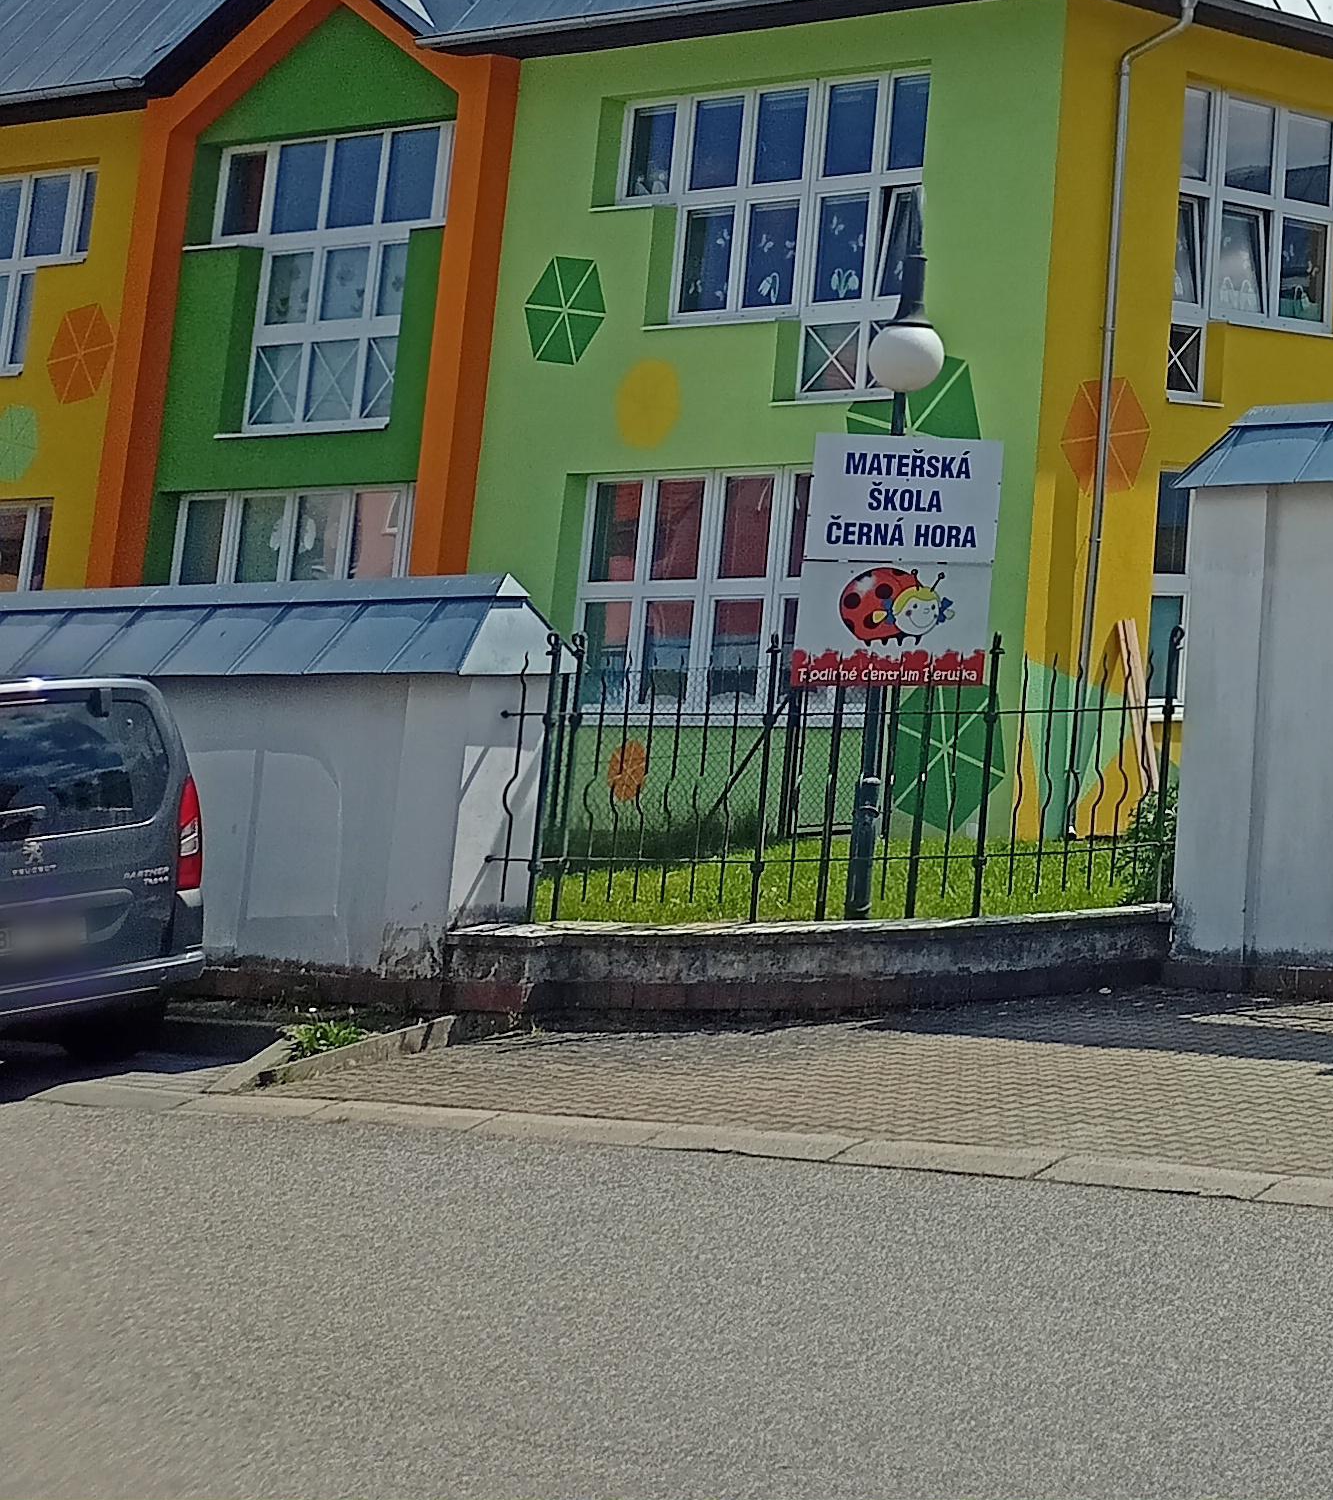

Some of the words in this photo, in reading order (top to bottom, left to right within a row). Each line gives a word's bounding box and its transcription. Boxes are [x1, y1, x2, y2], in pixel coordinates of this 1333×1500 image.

[845, 448, 971, 479] MATEŘSKÁ
[867, 481, 942, 512] ŠKOLA
[826, 515, 904, 546] ČERNÁ
[914, 524, 977, 548] HORA
